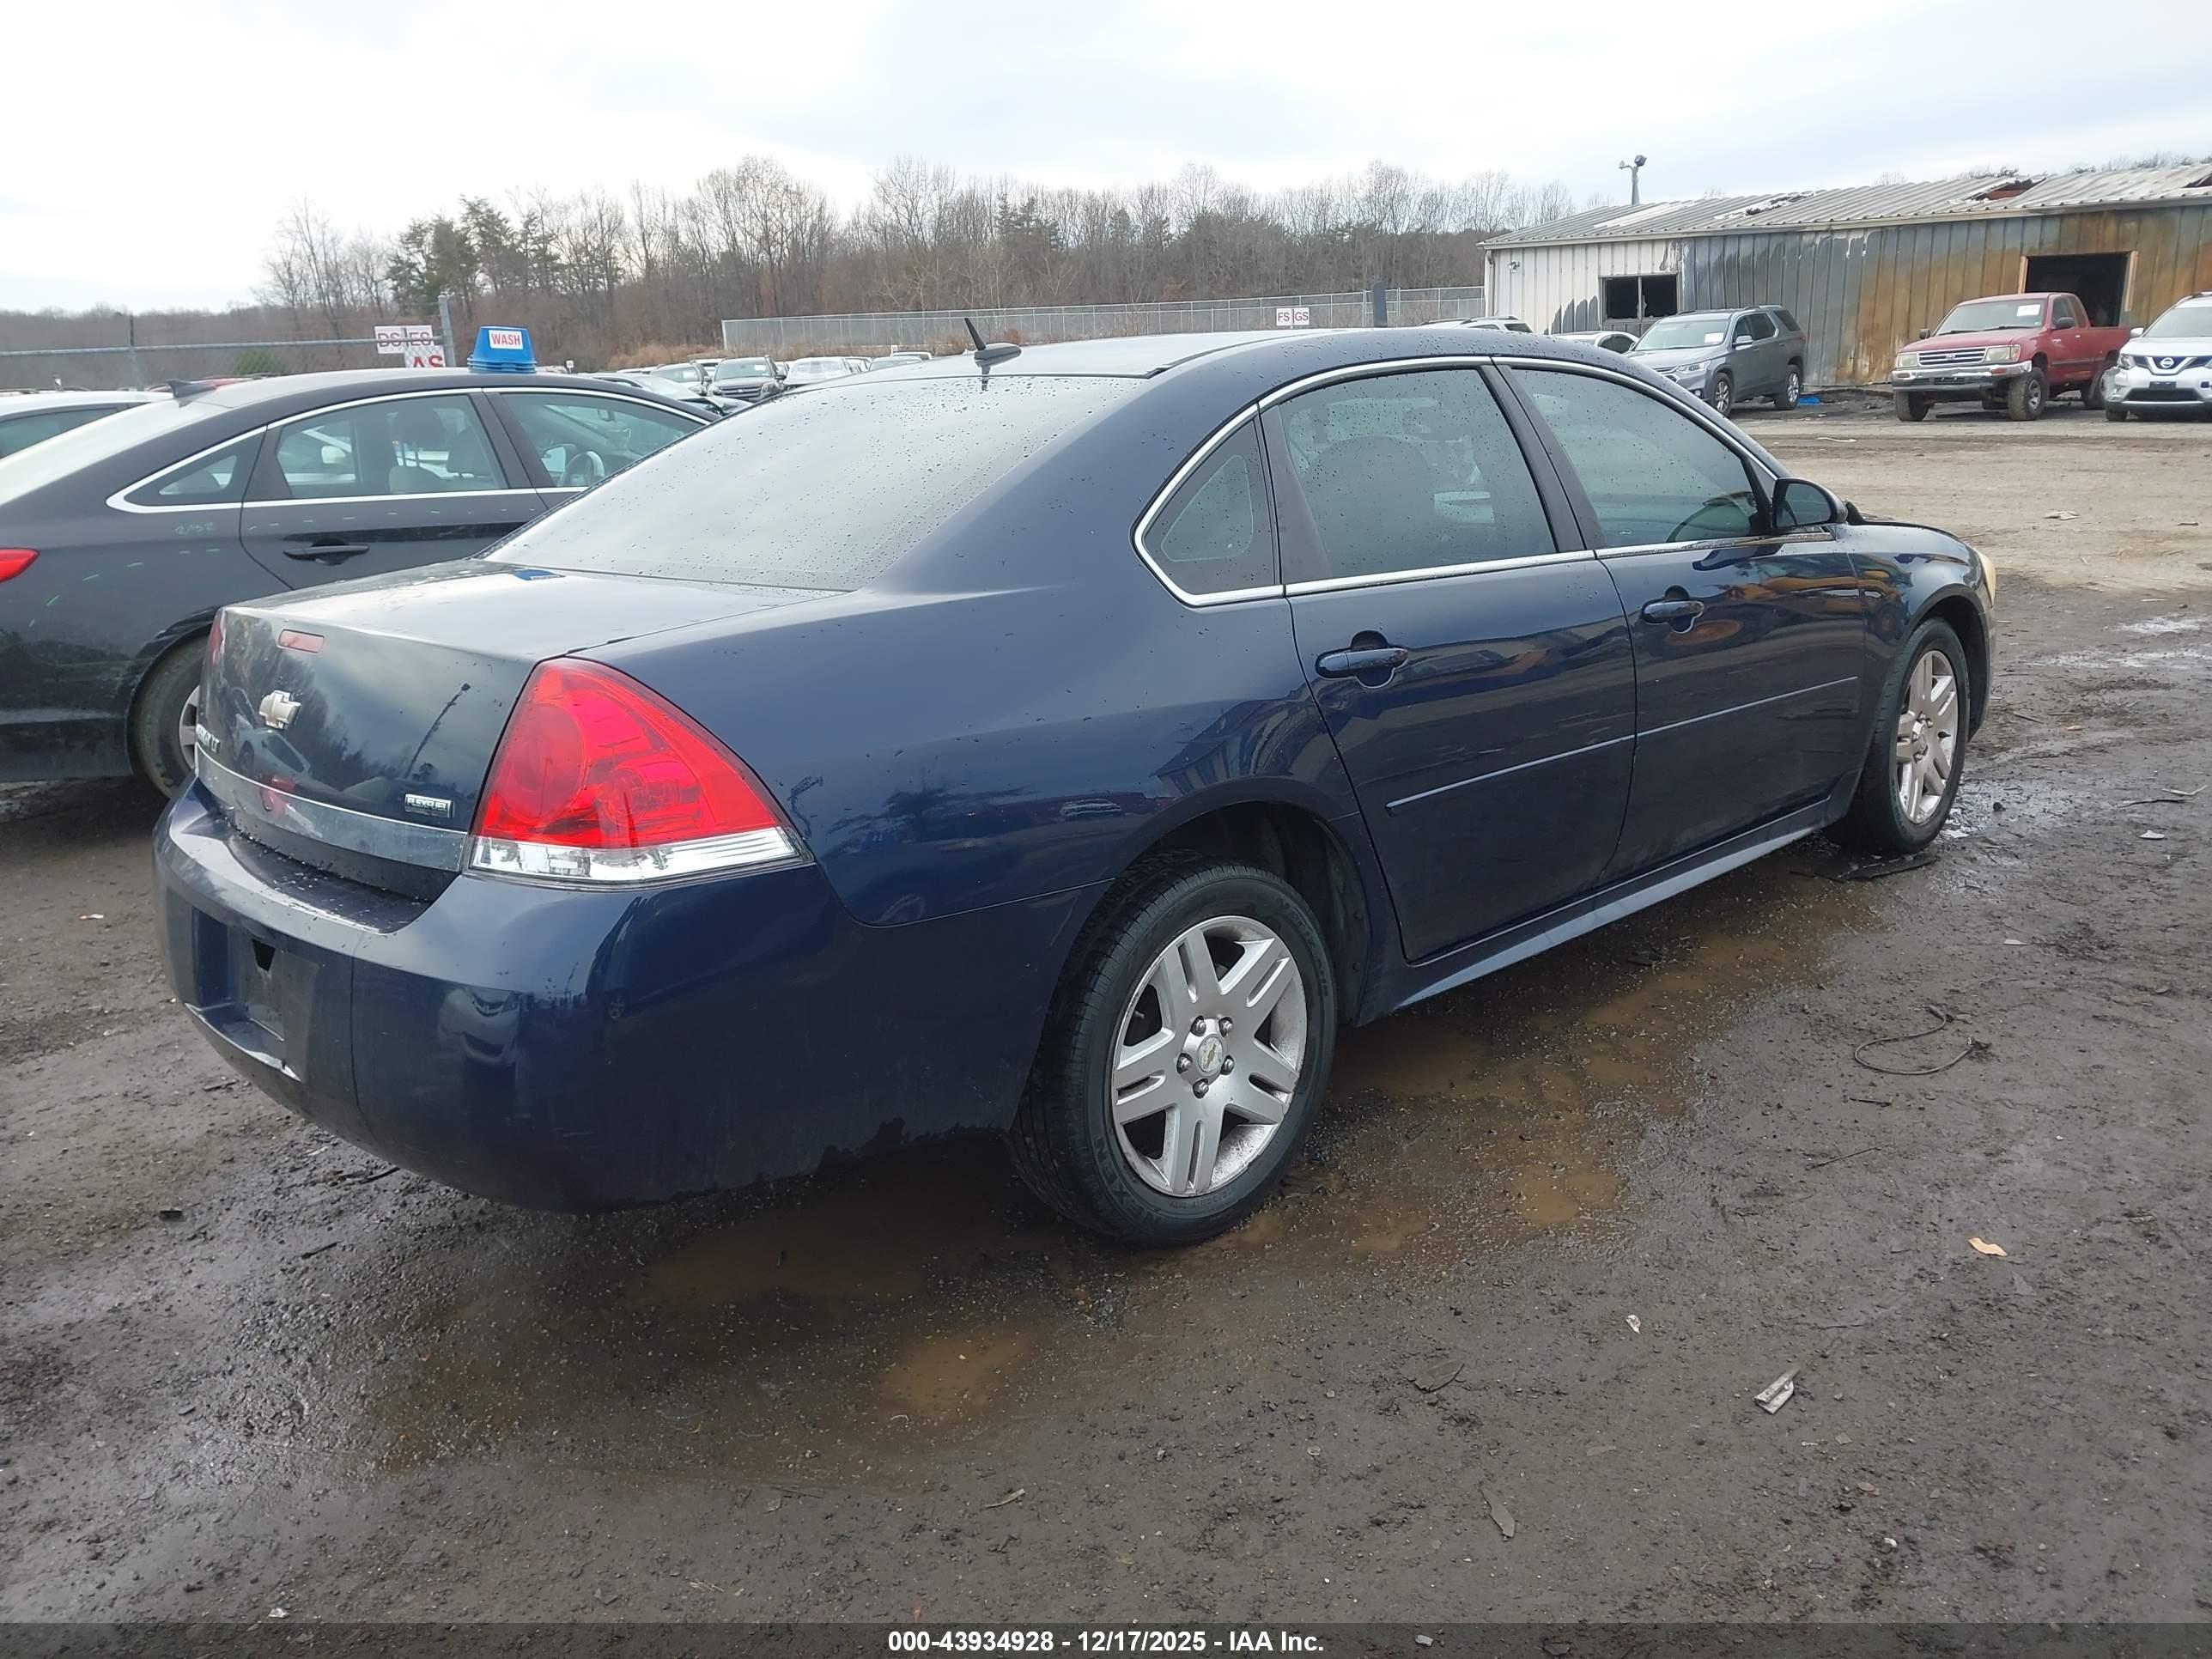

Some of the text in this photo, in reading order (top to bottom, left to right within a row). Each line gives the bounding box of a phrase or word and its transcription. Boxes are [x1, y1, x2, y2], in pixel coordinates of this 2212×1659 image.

[1277, 311, 1309, 322] FS GS
[491, 333, 521, 346] WASH
